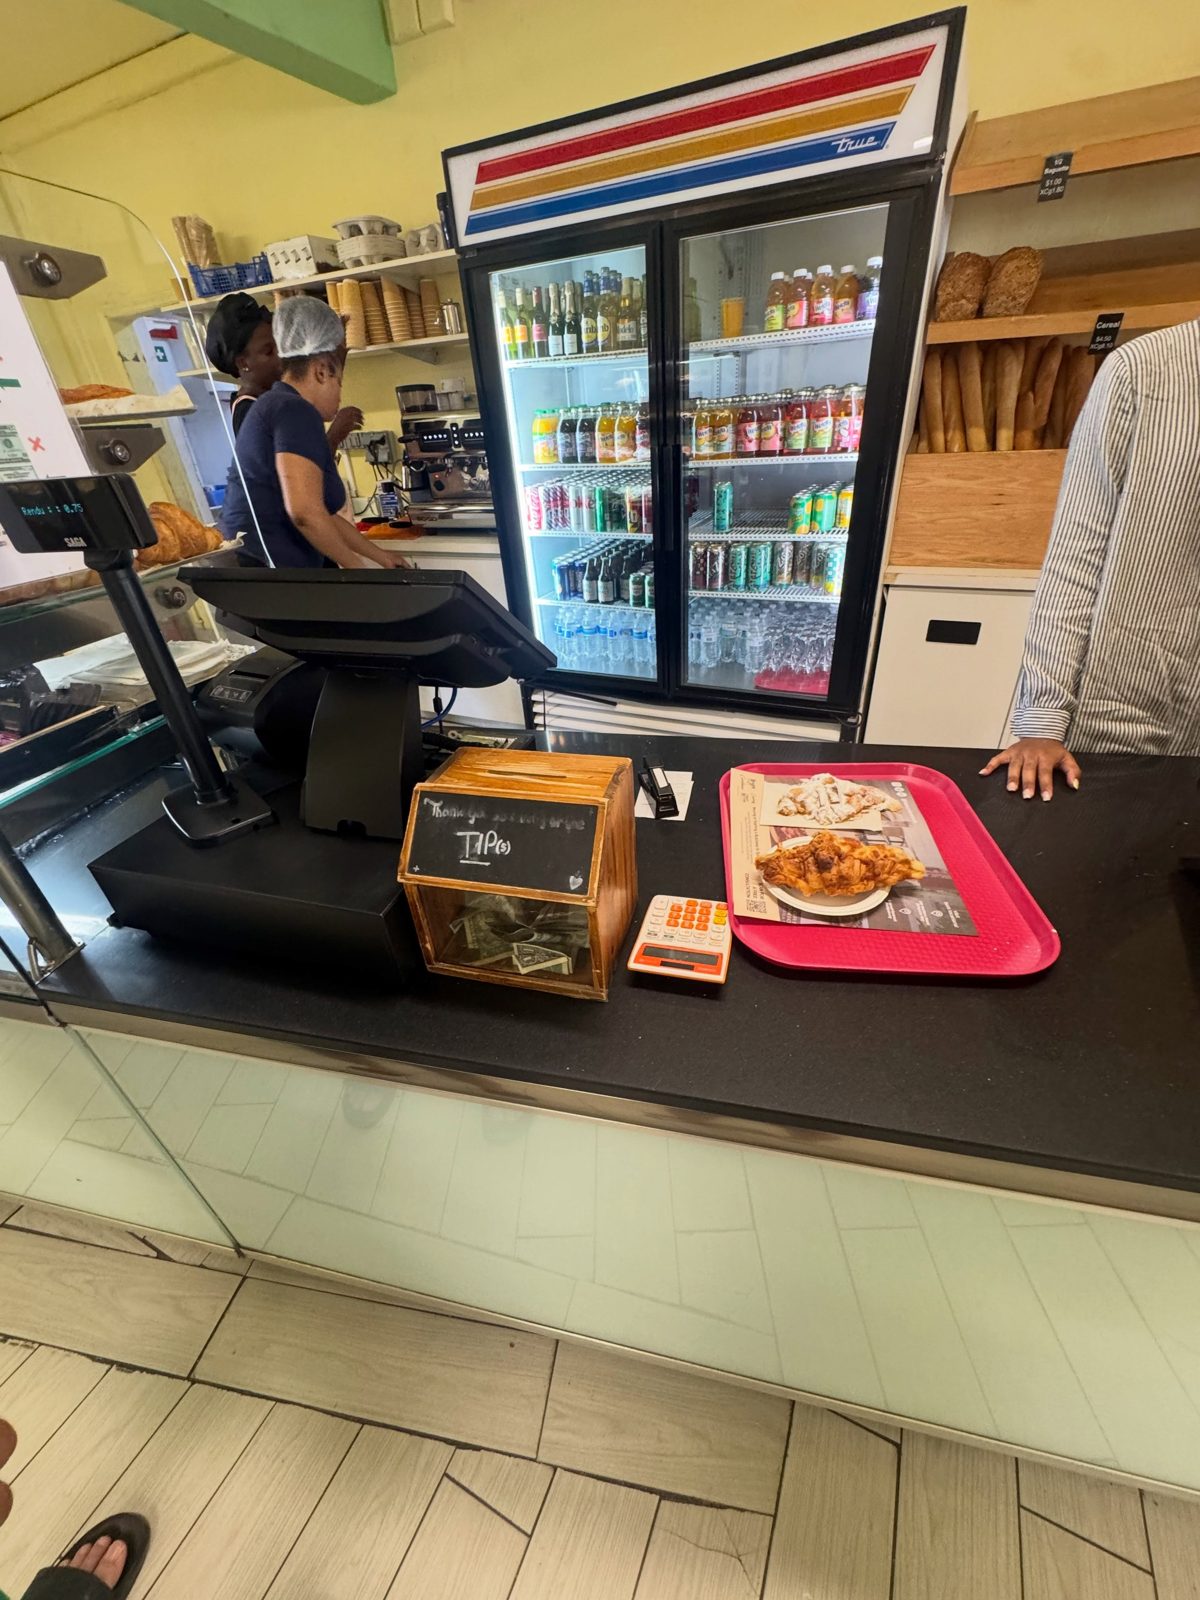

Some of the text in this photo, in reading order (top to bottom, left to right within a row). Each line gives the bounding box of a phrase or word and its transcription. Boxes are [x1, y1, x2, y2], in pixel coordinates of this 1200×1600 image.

[831, 136, 878, 153] true
[1096, 320, 1121, 329] Cereal
[63, 503, 84, 514] 0.75
[424, 798, 464, 819] Thank
